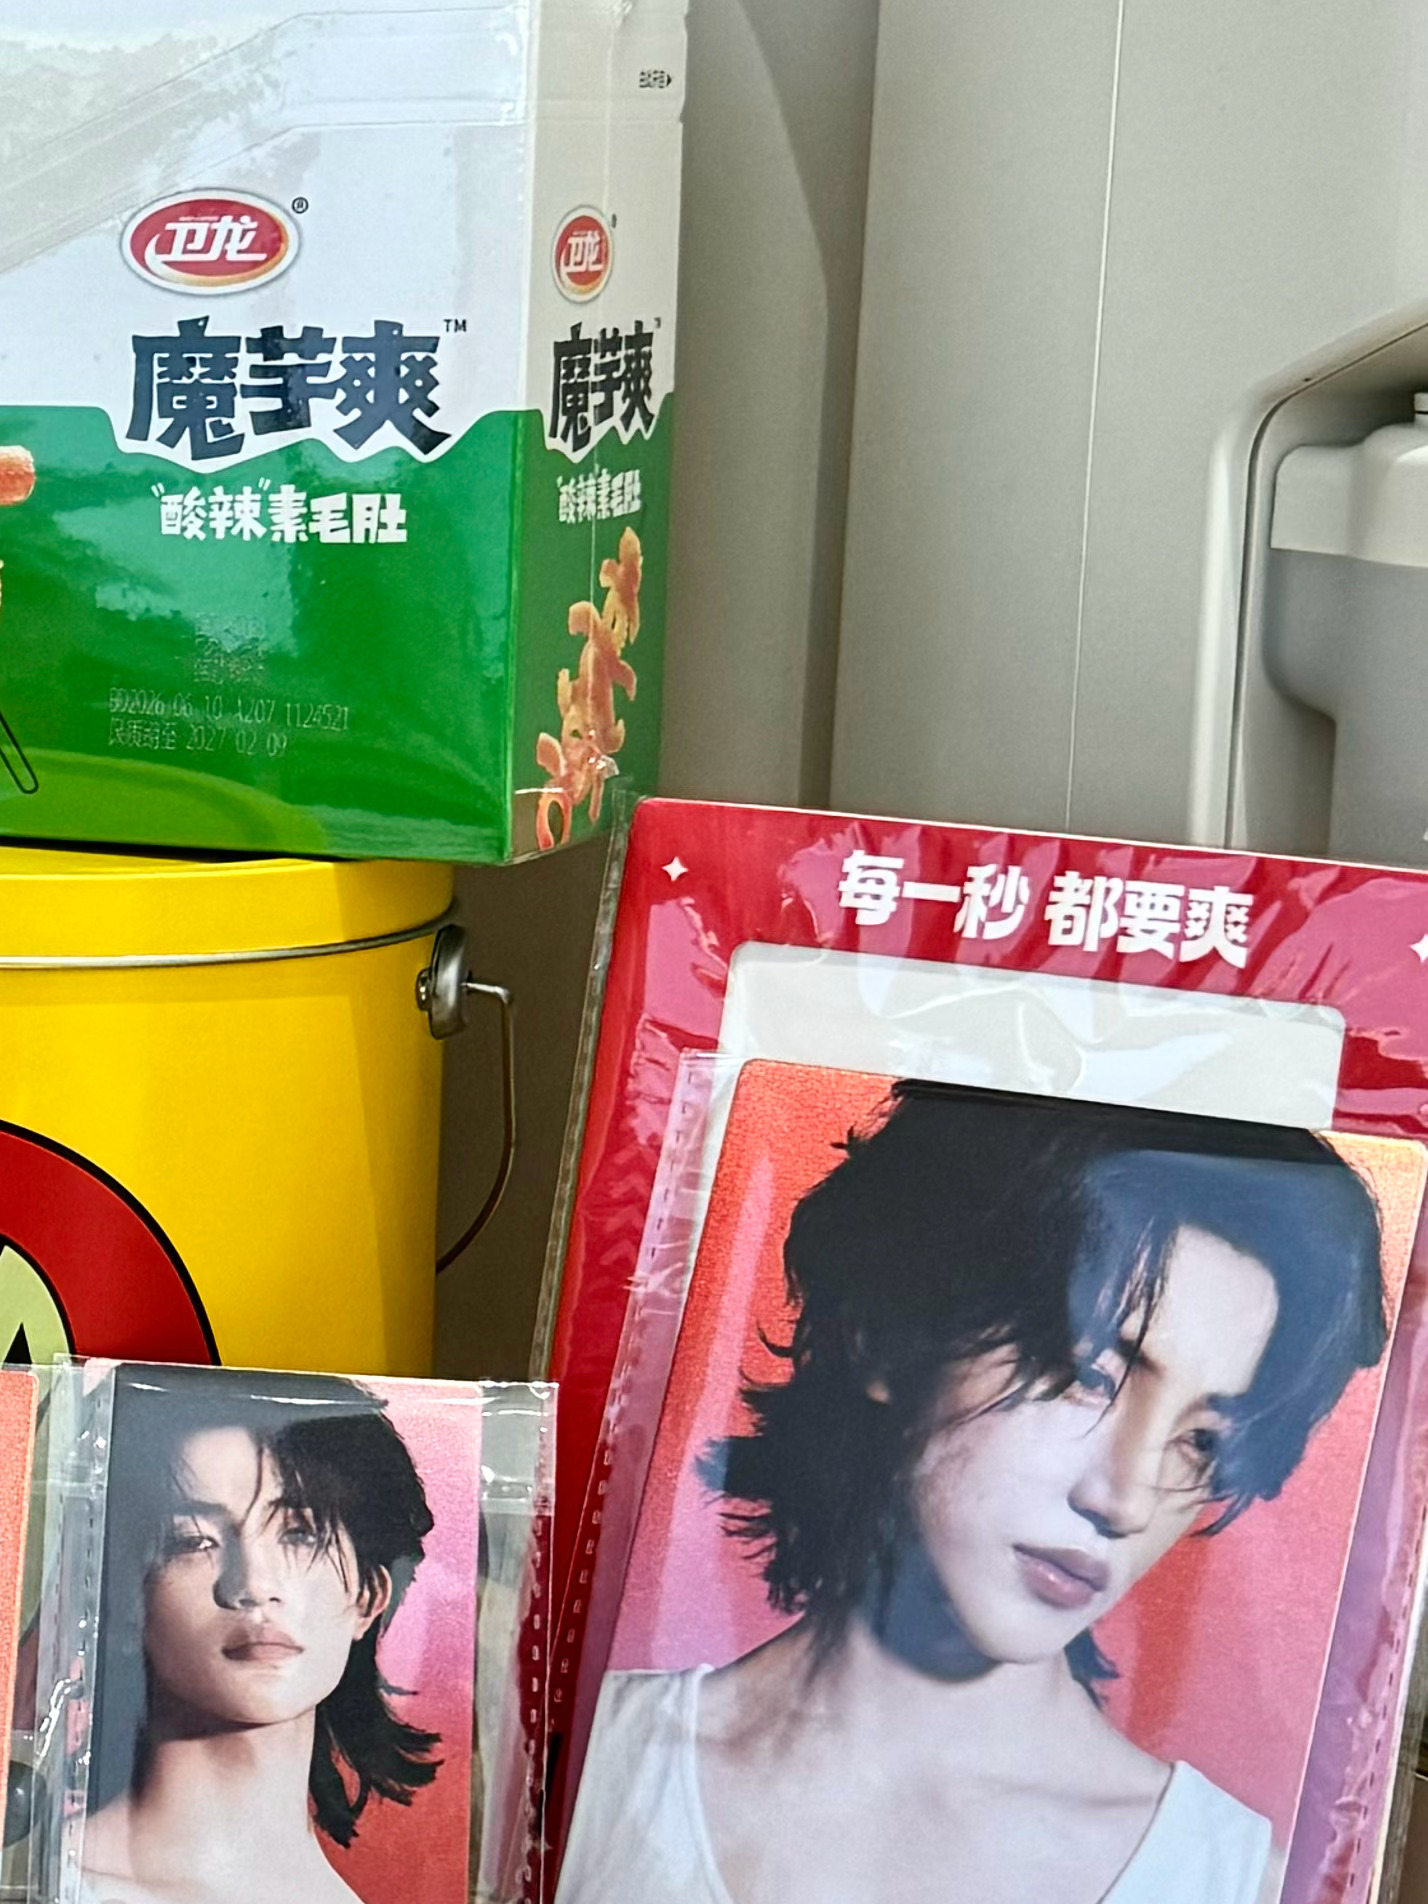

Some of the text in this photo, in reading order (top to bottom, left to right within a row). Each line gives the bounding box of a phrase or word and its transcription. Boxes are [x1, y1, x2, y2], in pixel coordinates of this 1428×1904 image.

[158, 214, 268, 261] 卫龙
[562, 230, 605, 273] 卫龙
[126, 315, 467, 461] 魔芋爽 TM
[549, 319, 655, 453] 魔芋爽
[838, 849, 1255, 971] 每一秒 都要爽
